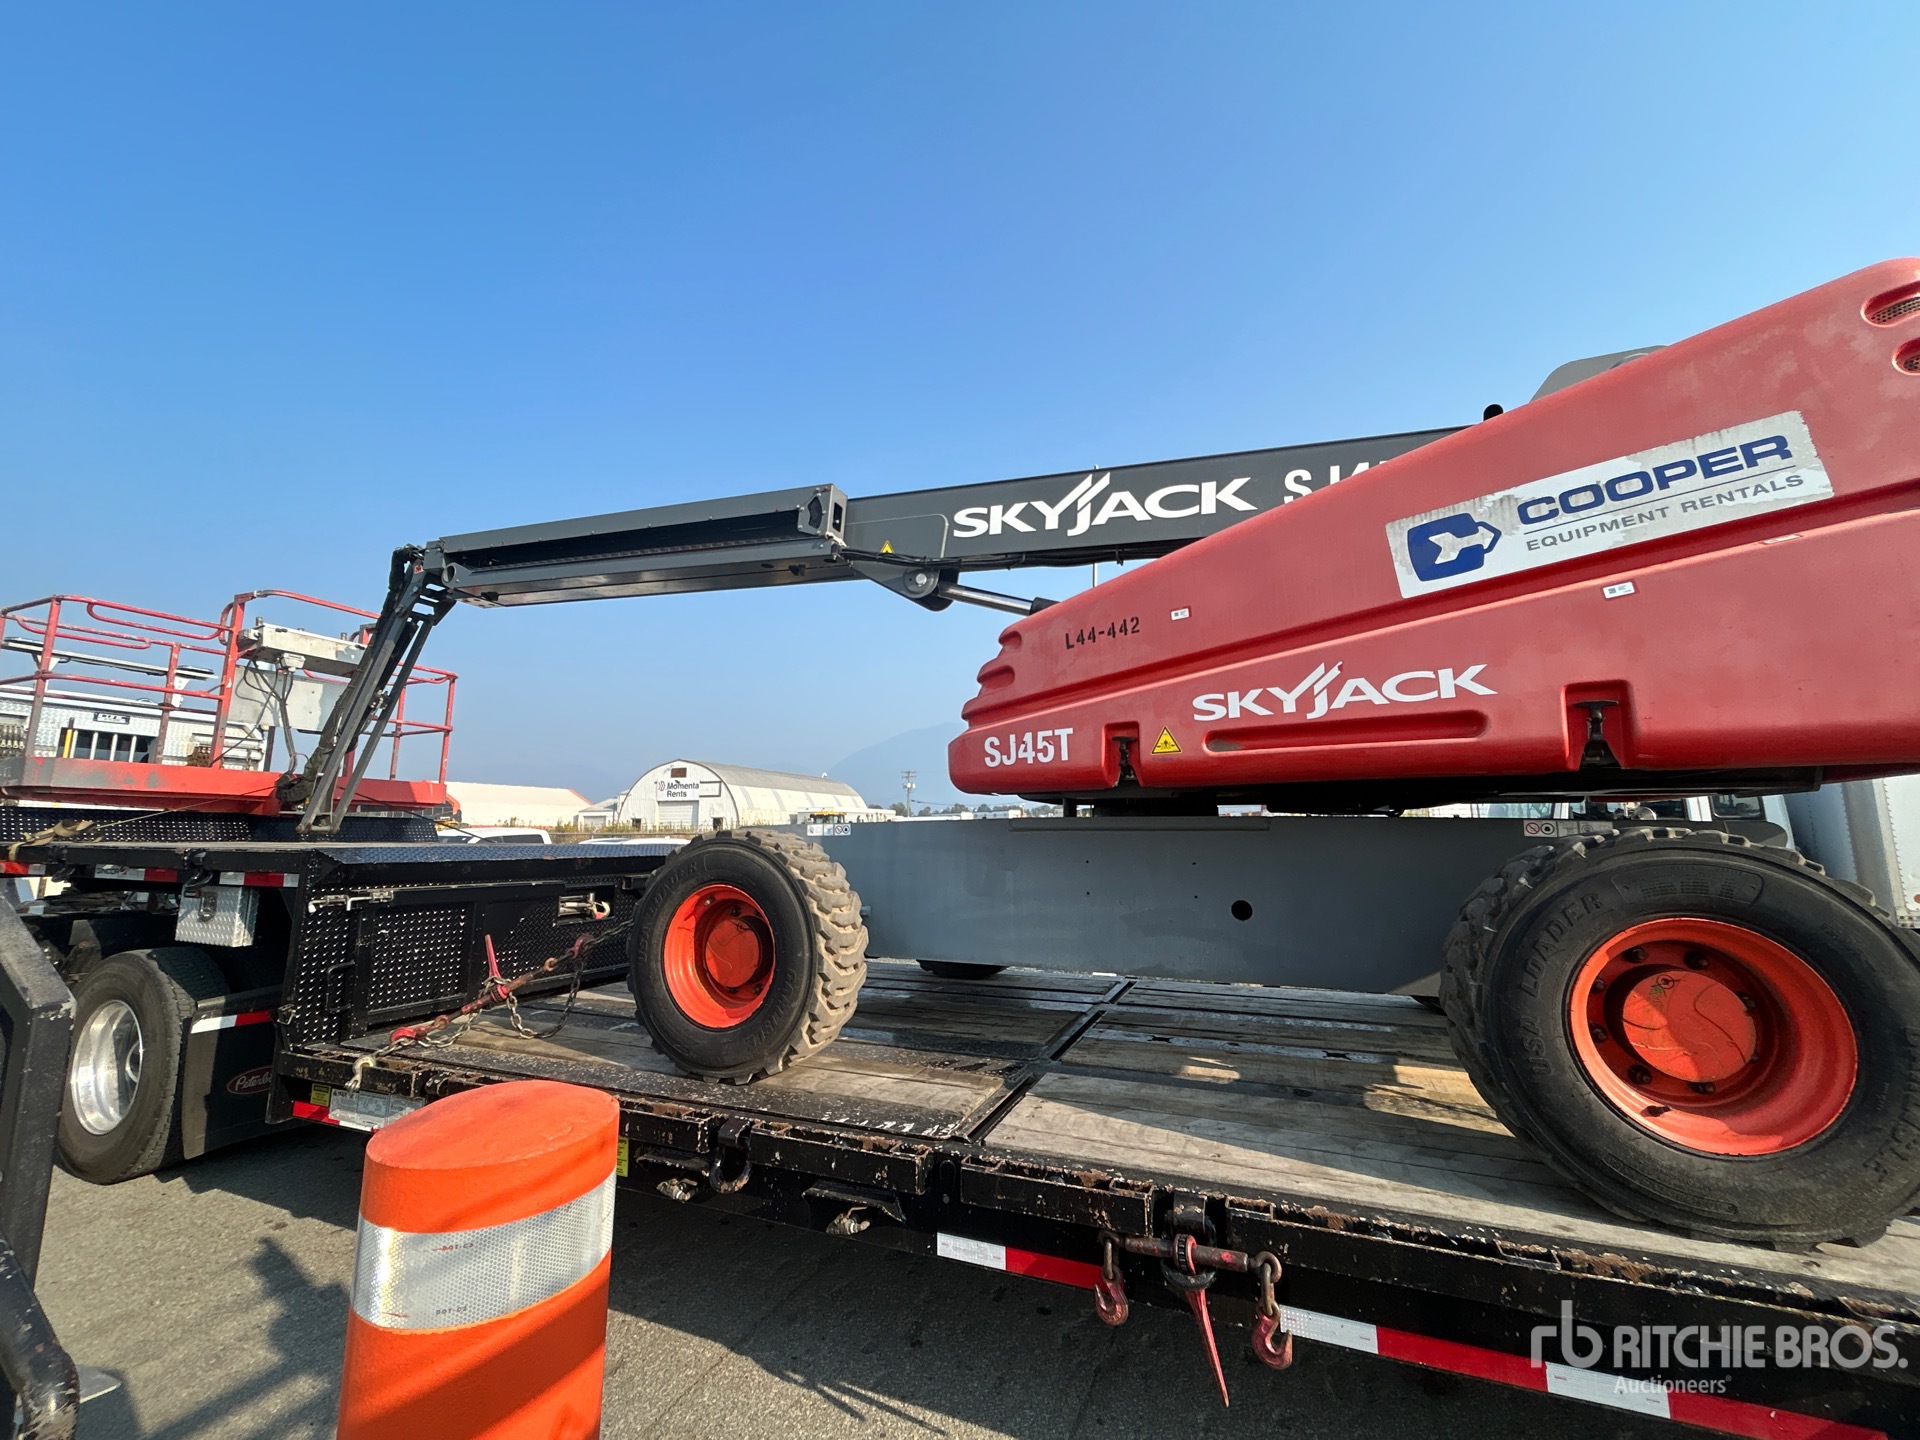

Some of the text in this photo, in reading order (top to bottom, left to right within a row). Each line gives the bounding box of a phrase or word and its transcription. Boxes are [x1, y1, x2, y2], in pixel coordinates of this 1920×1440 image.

[952, 470, 1258, 537] SKYJACK
[1517, 434, 1793, 526] COOPER
[1526, 473, 1805, 552] EQUIPMENT RENTALS
[1064, 615, 1141, 650] L44-442
[1192, 660, 1497, 720] SKYJACK
[984, 728, 1075, 768] SJ45T
[666, 790, 688, 798] Rents
[667, 781, 699, 790] Momenta
[1520, 892, 1603, 1077] USA LOADER
